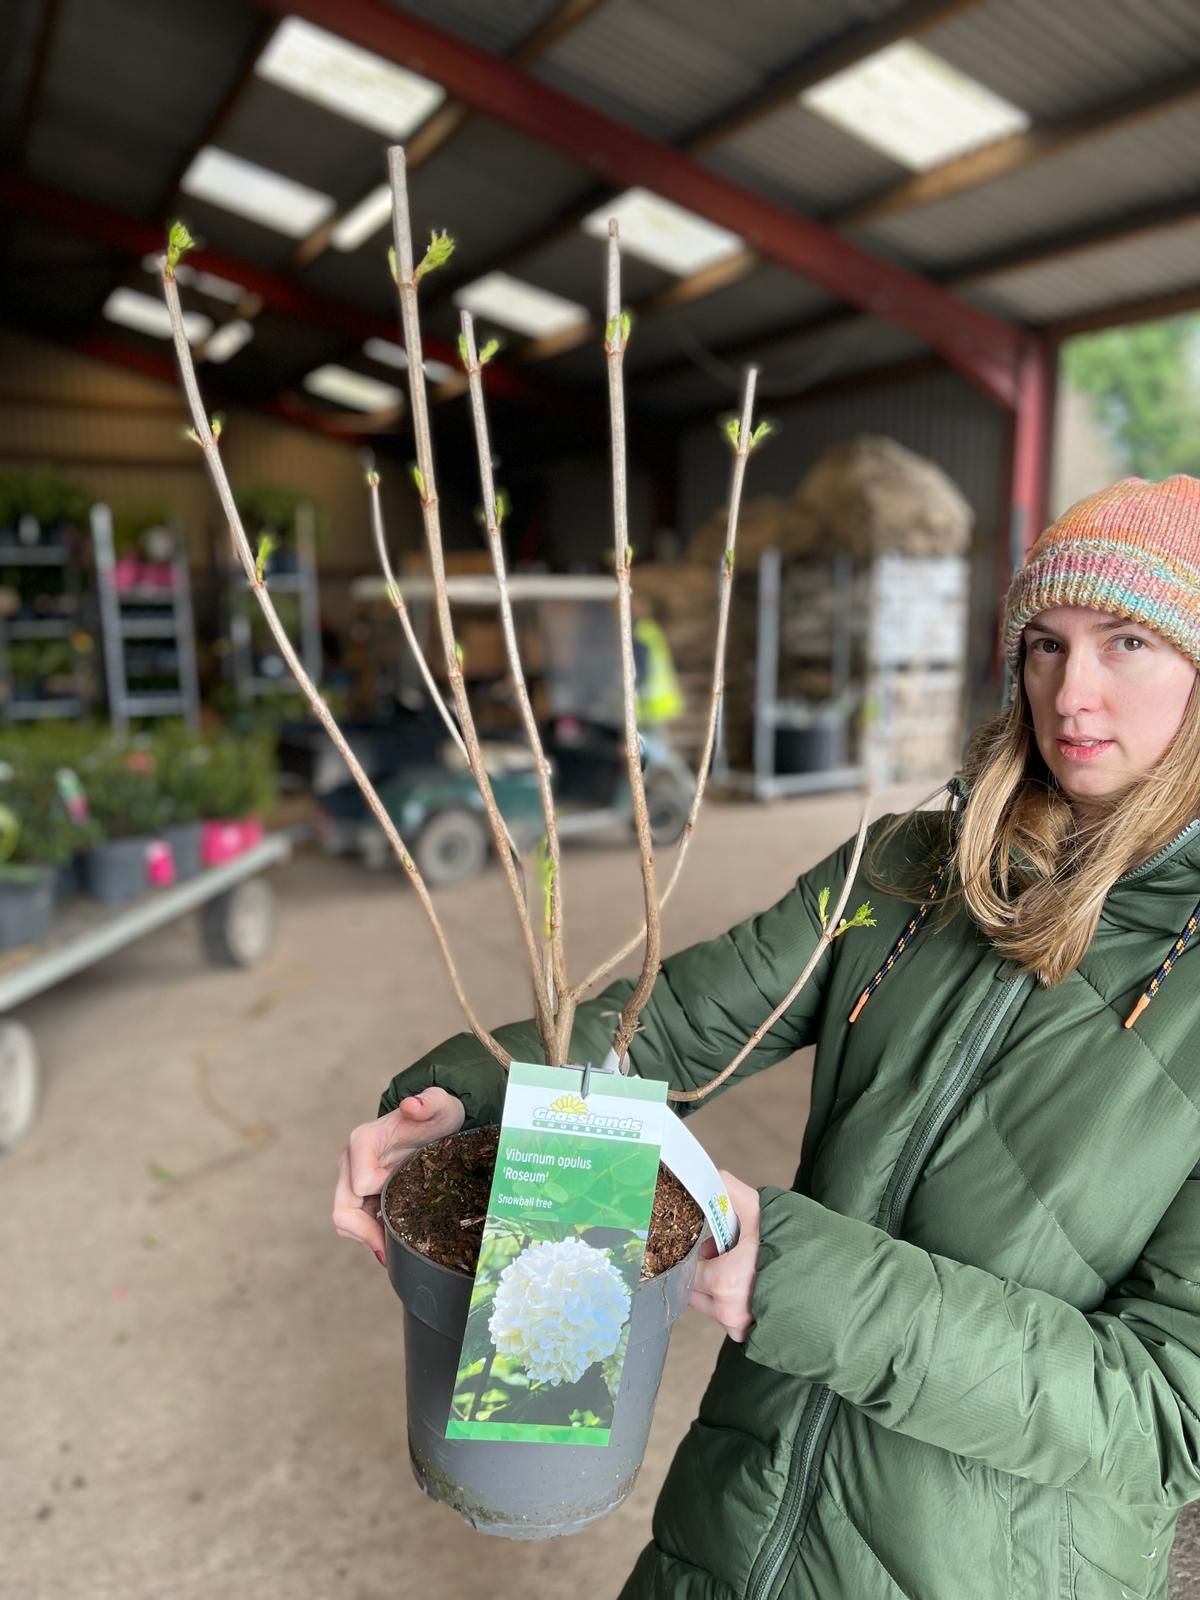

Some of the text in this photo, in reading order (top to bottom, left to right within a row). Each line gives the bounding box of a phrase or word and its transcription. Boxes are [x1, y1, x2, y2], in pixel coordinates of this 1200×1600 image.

[547, 1123, 626, 1137] NURSERY
[506, 1148, 592, 1170] Viburnum opulus
[503, 1166, 550, 1183] 'Roseum'
[497, 1193, 553, 1209] Snowball tree
